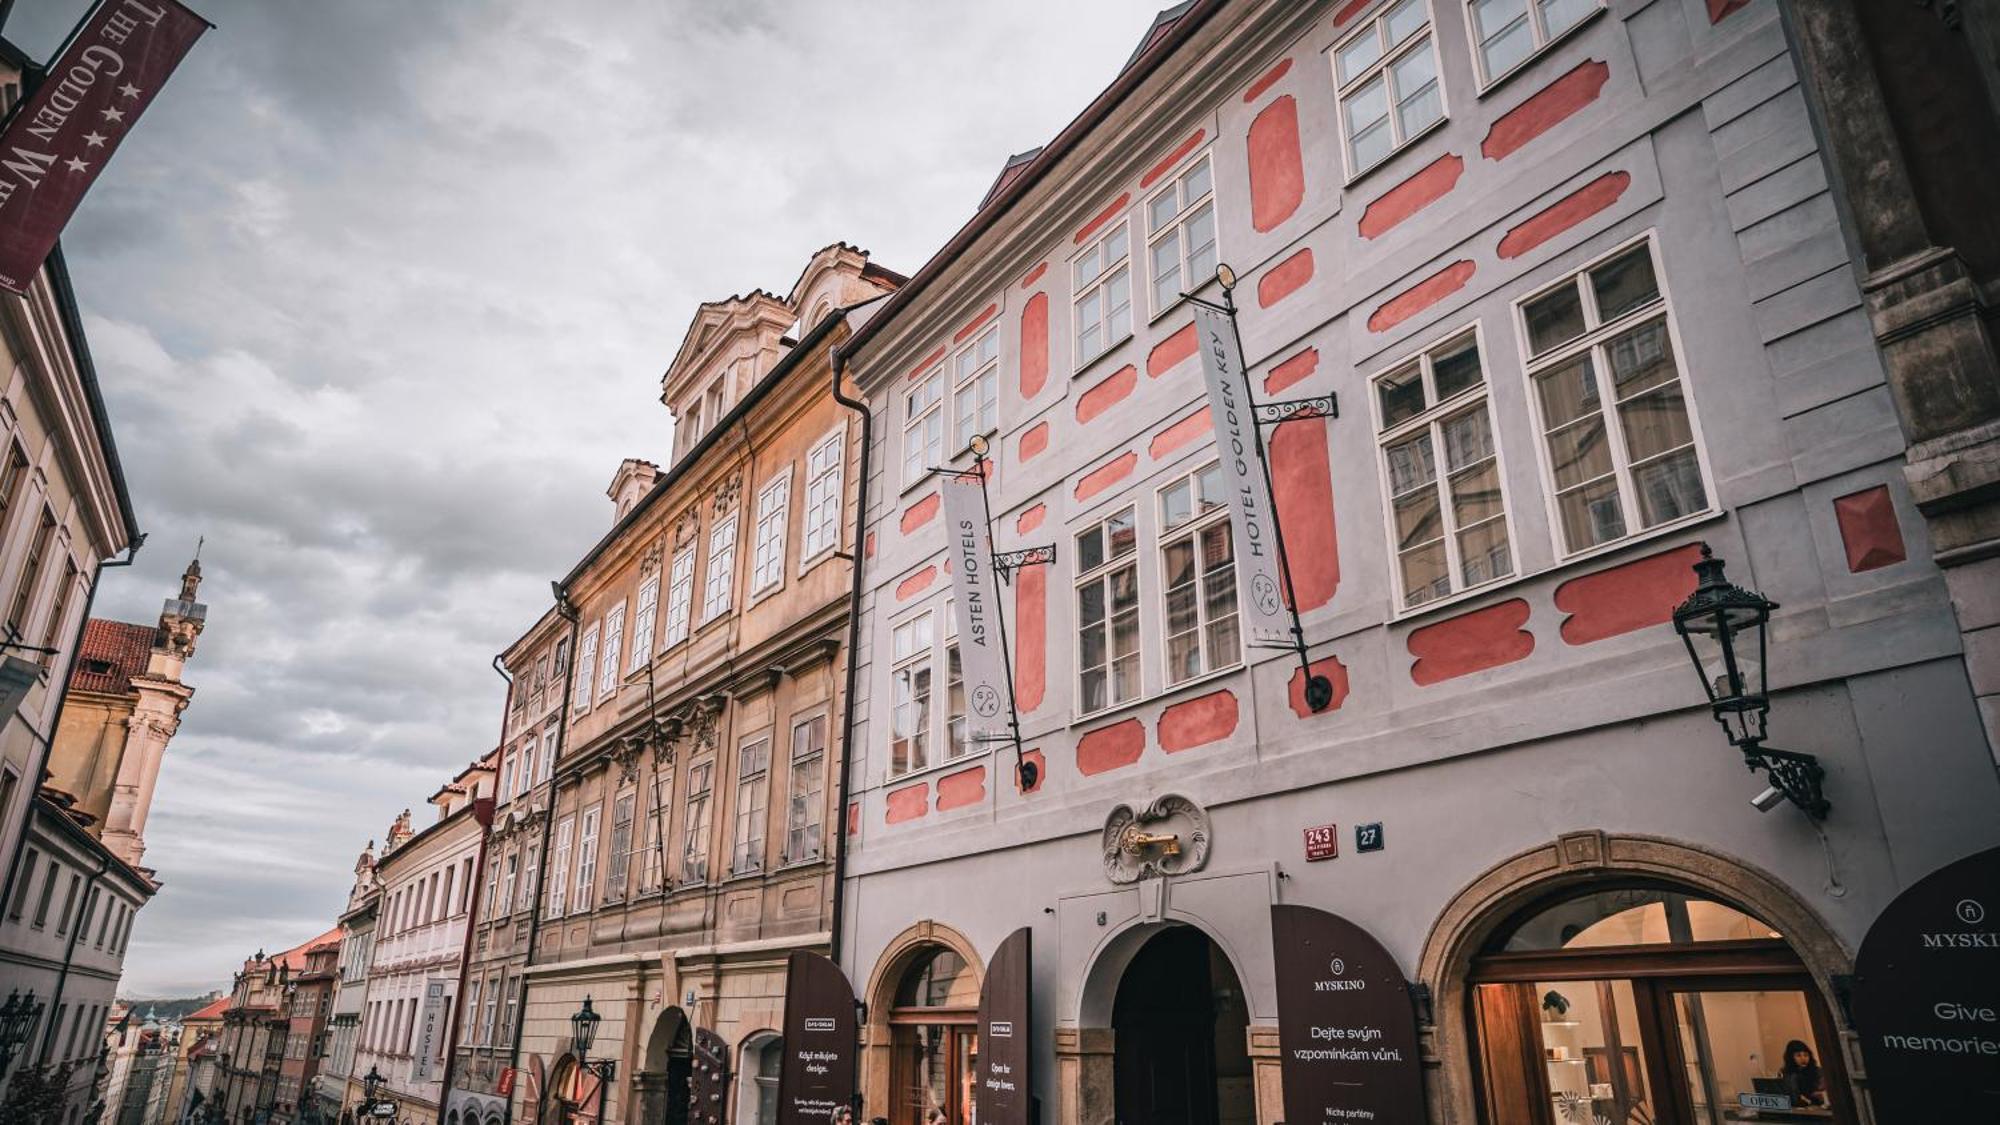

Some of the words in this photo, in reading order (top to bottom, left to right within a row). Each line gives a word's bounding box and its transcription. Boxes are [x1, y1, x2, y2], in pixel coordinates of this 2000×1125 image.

[101, 0, 167, 45] THE
[26, 45, 124, 143] GOLDEN
[0, 146, 59, 208] WH
[1210, 331, 1228, 374] KEY
[1221, 380, 1248, 477] GOLDEN
[1240, 485, 1264, 557] HOTEL
[960, 520, 979, 585] HOTELS
[968, 591, 986, 647] ASTEN
[1308, 828, 1331, 846] 243
[1360, 829, 1376, 846] 27
[1315, 980, 1365, 991] MYSKINO
[1311, 1027, 1344, 1041] Dejte
[1347, 1026, 1381, 1041] svým
[1934, 1002, 1997, 1022] Give
[419, 1012, 436, 1077] HOSTEL
[1294, 1047, 1369, 1062] vzpomínkám
[1883, 1034, 2000, 1055] memorie
[1750, 1096, 1779, 1107] OPEN
